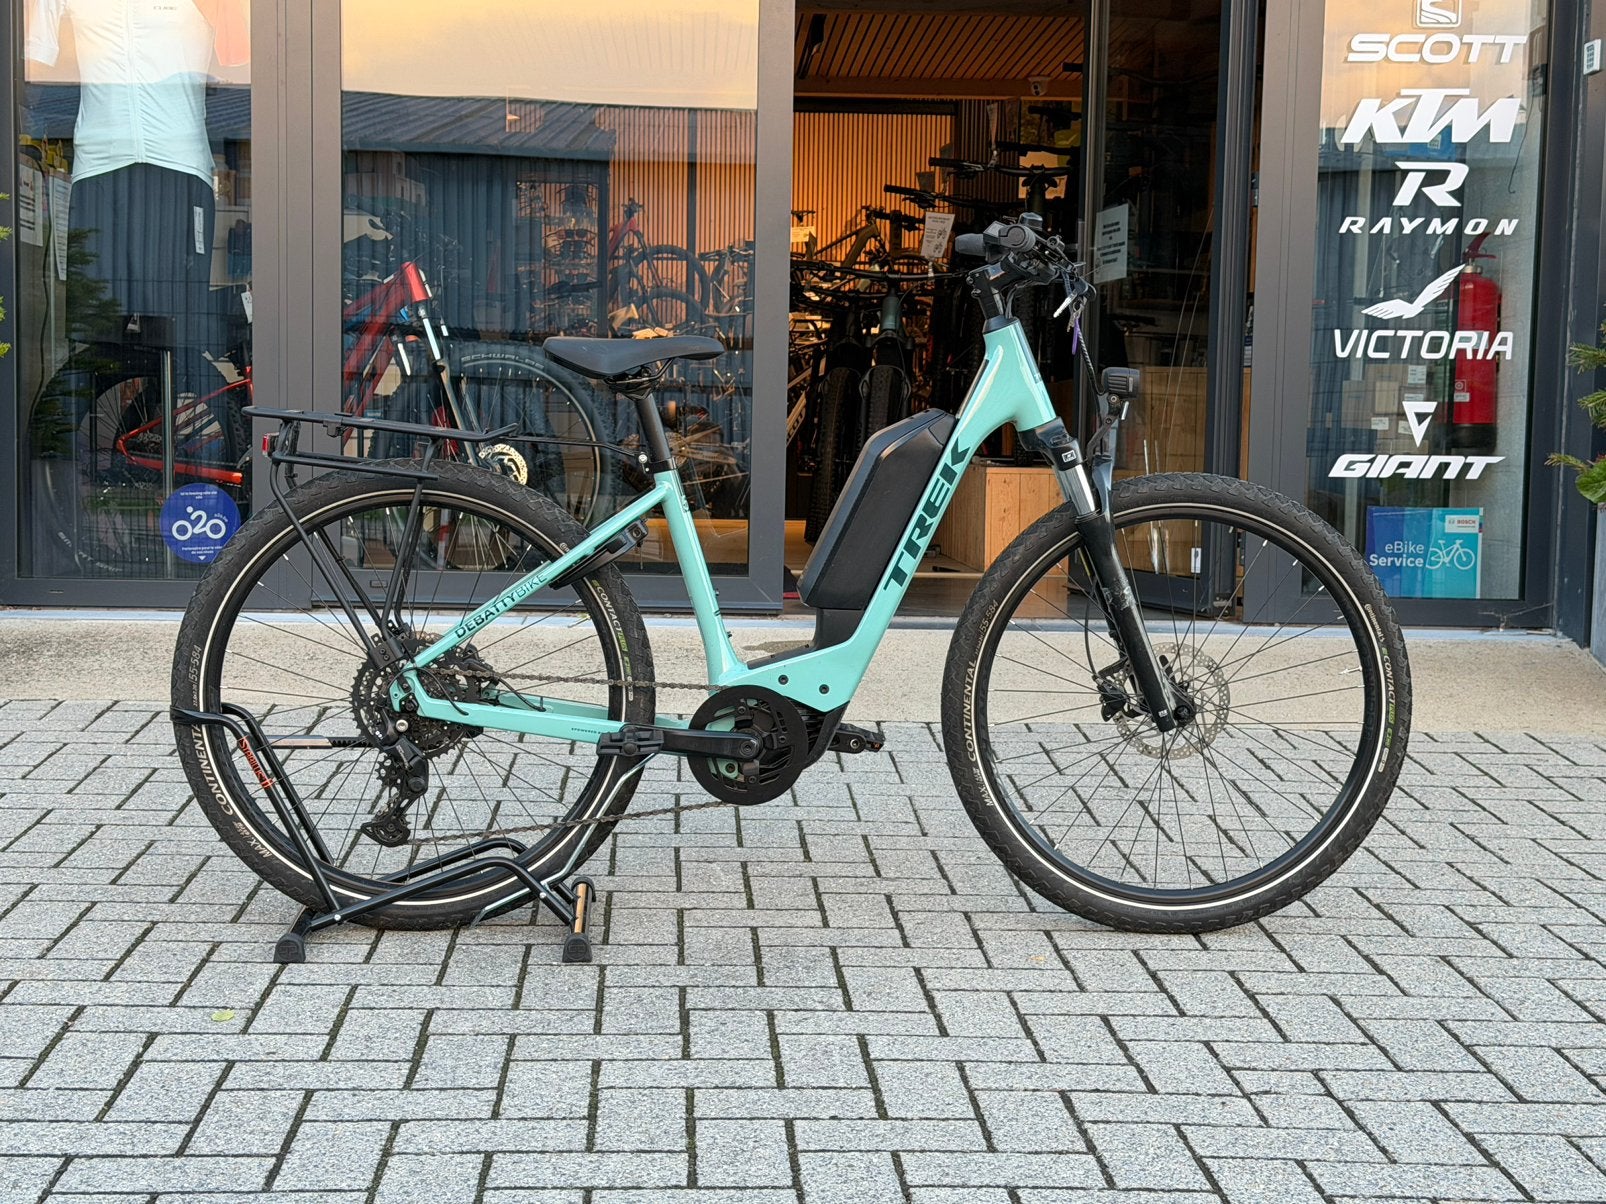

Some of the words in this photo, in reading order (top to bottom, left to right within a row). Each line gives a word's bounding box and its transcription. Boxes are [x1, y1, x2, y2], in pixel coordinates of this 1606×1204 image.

[1347, 33, 1528, 63] SCOTT
[1341, 88, 1521, 144] KTM
[1338, 216, 1519, 236] RAYMON
[1333, 329, 1513, 360] VICTORIA
[1328, 454, 1506, 480] GIANT
[883, 436, 971, 591] TREK
[1369, 553, 1424, 567] Service
[1384, 540, 1425, 554] eBike
[963, 660, 977, 762] CONTINENTAL
[192, 723, 233, 816] CONTINENTA
